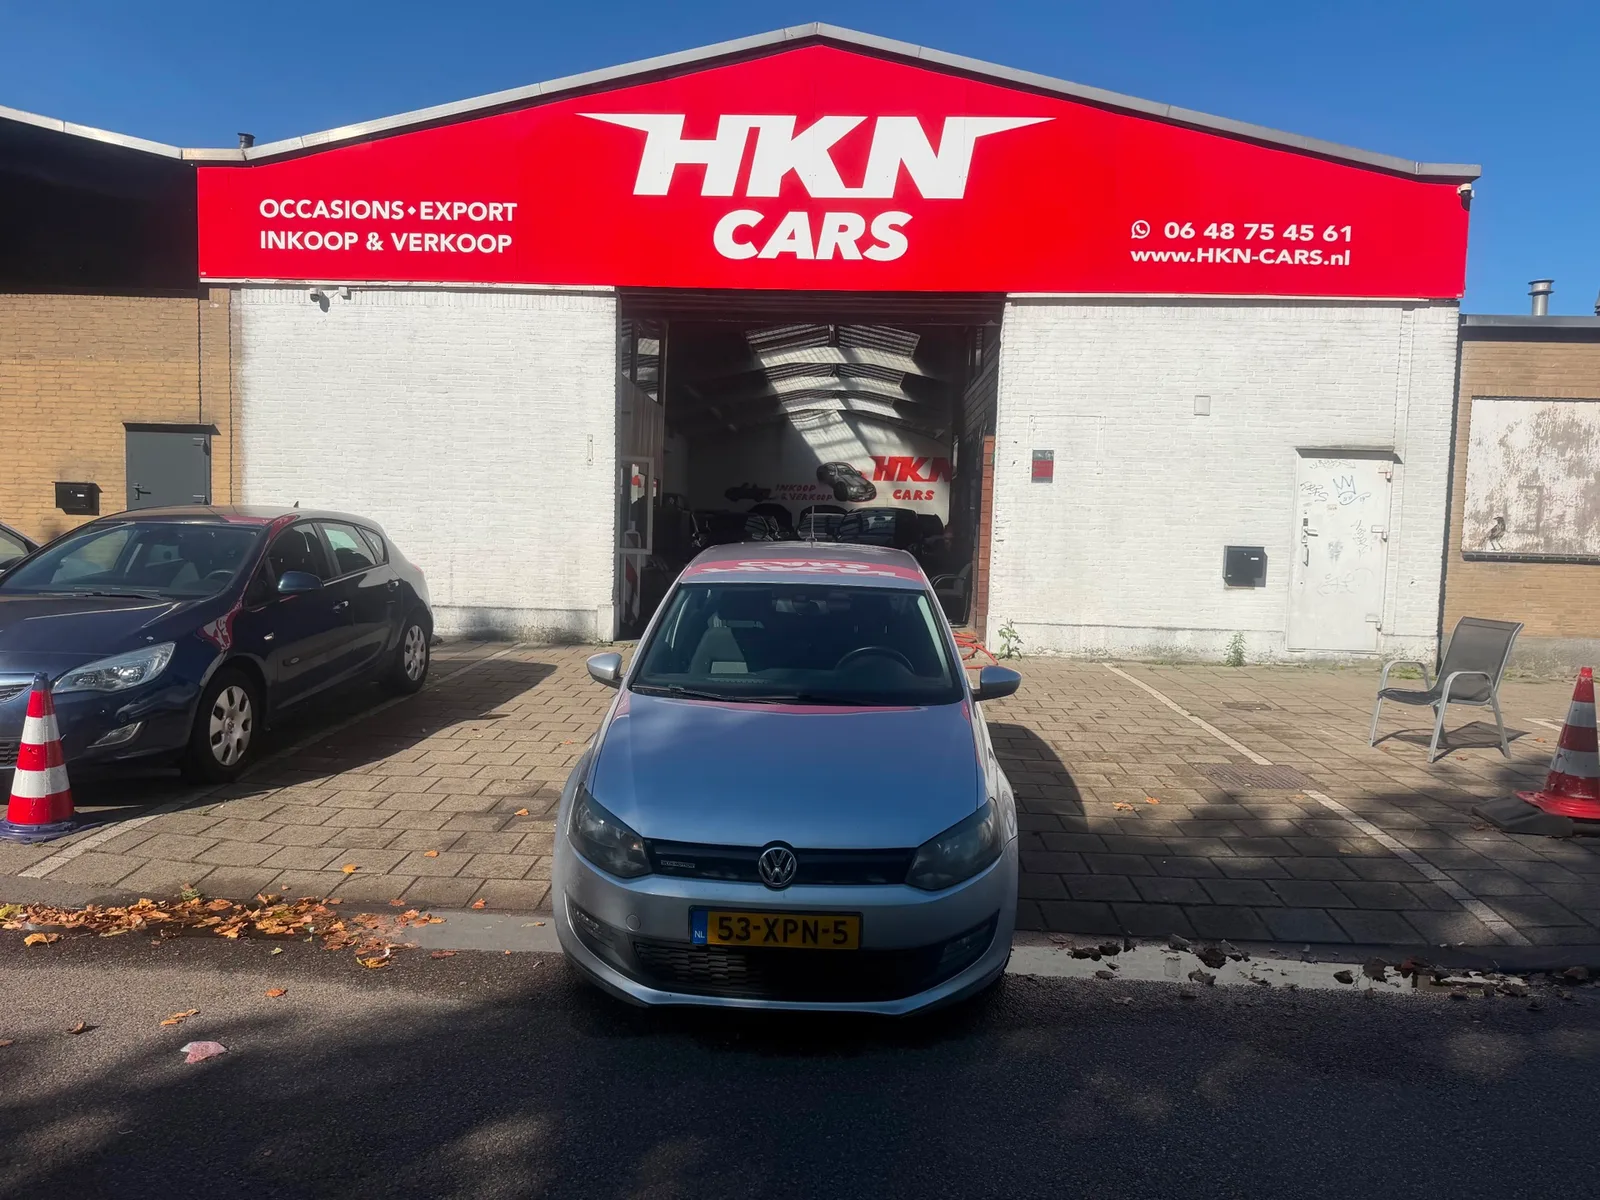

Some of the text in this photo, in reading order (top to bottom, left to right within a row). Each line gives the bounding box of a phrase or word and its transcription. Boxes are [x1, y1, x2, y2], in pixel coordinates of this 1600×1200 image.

[574, 112, 1058, 200] HKN
[712, 208, 914, 262] CARS
[1163, 221, 1352, 242] 06 48 75 45 61
[260, 230, 512, 254] INKOOP & VERKOOP
[1130, 247, 1351, 266] www.HKN-CARS.nl
[775, 483, 817, 492] INKOOP
[789, 493, 833, 501] VERKOOP
[893, 489, 935, 501] CARS
[694, 930, 706, 939] NL
[717, 915, 849, 945] 53-XPN-5
